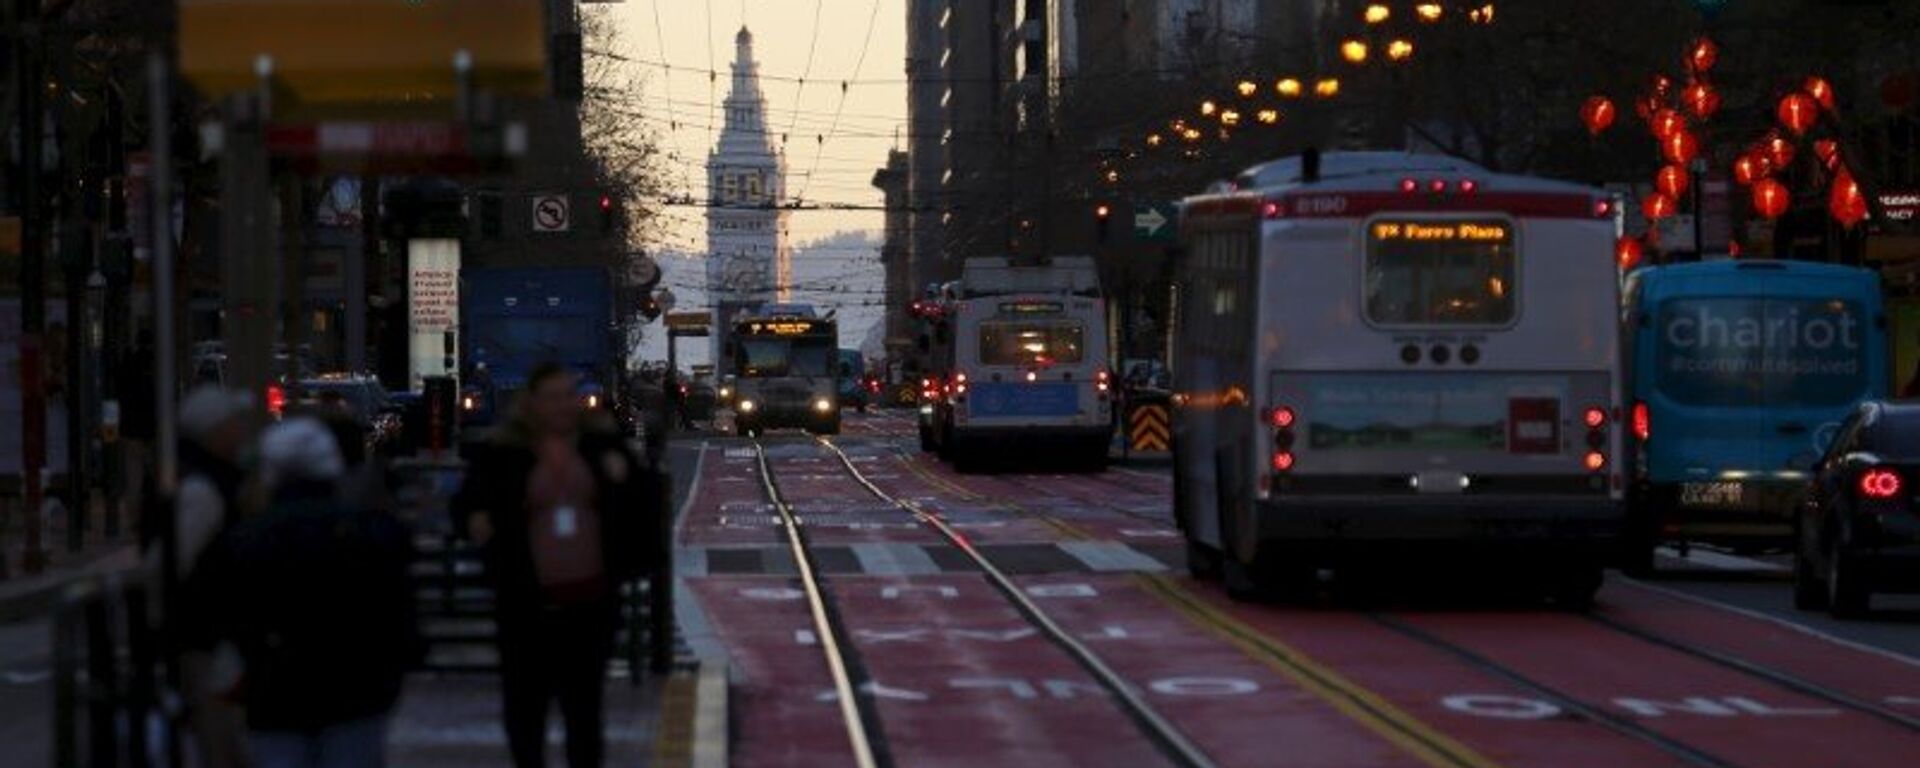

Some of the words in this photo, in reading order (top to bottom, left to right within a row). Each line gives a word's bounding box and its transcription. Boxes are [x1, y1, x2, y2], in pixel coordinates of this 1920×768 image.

[1405, 223, 1455, 239] Ferry
[1459, 223, 1504, 239] Plaza
[1667, 307, 1859, 350] chariot
